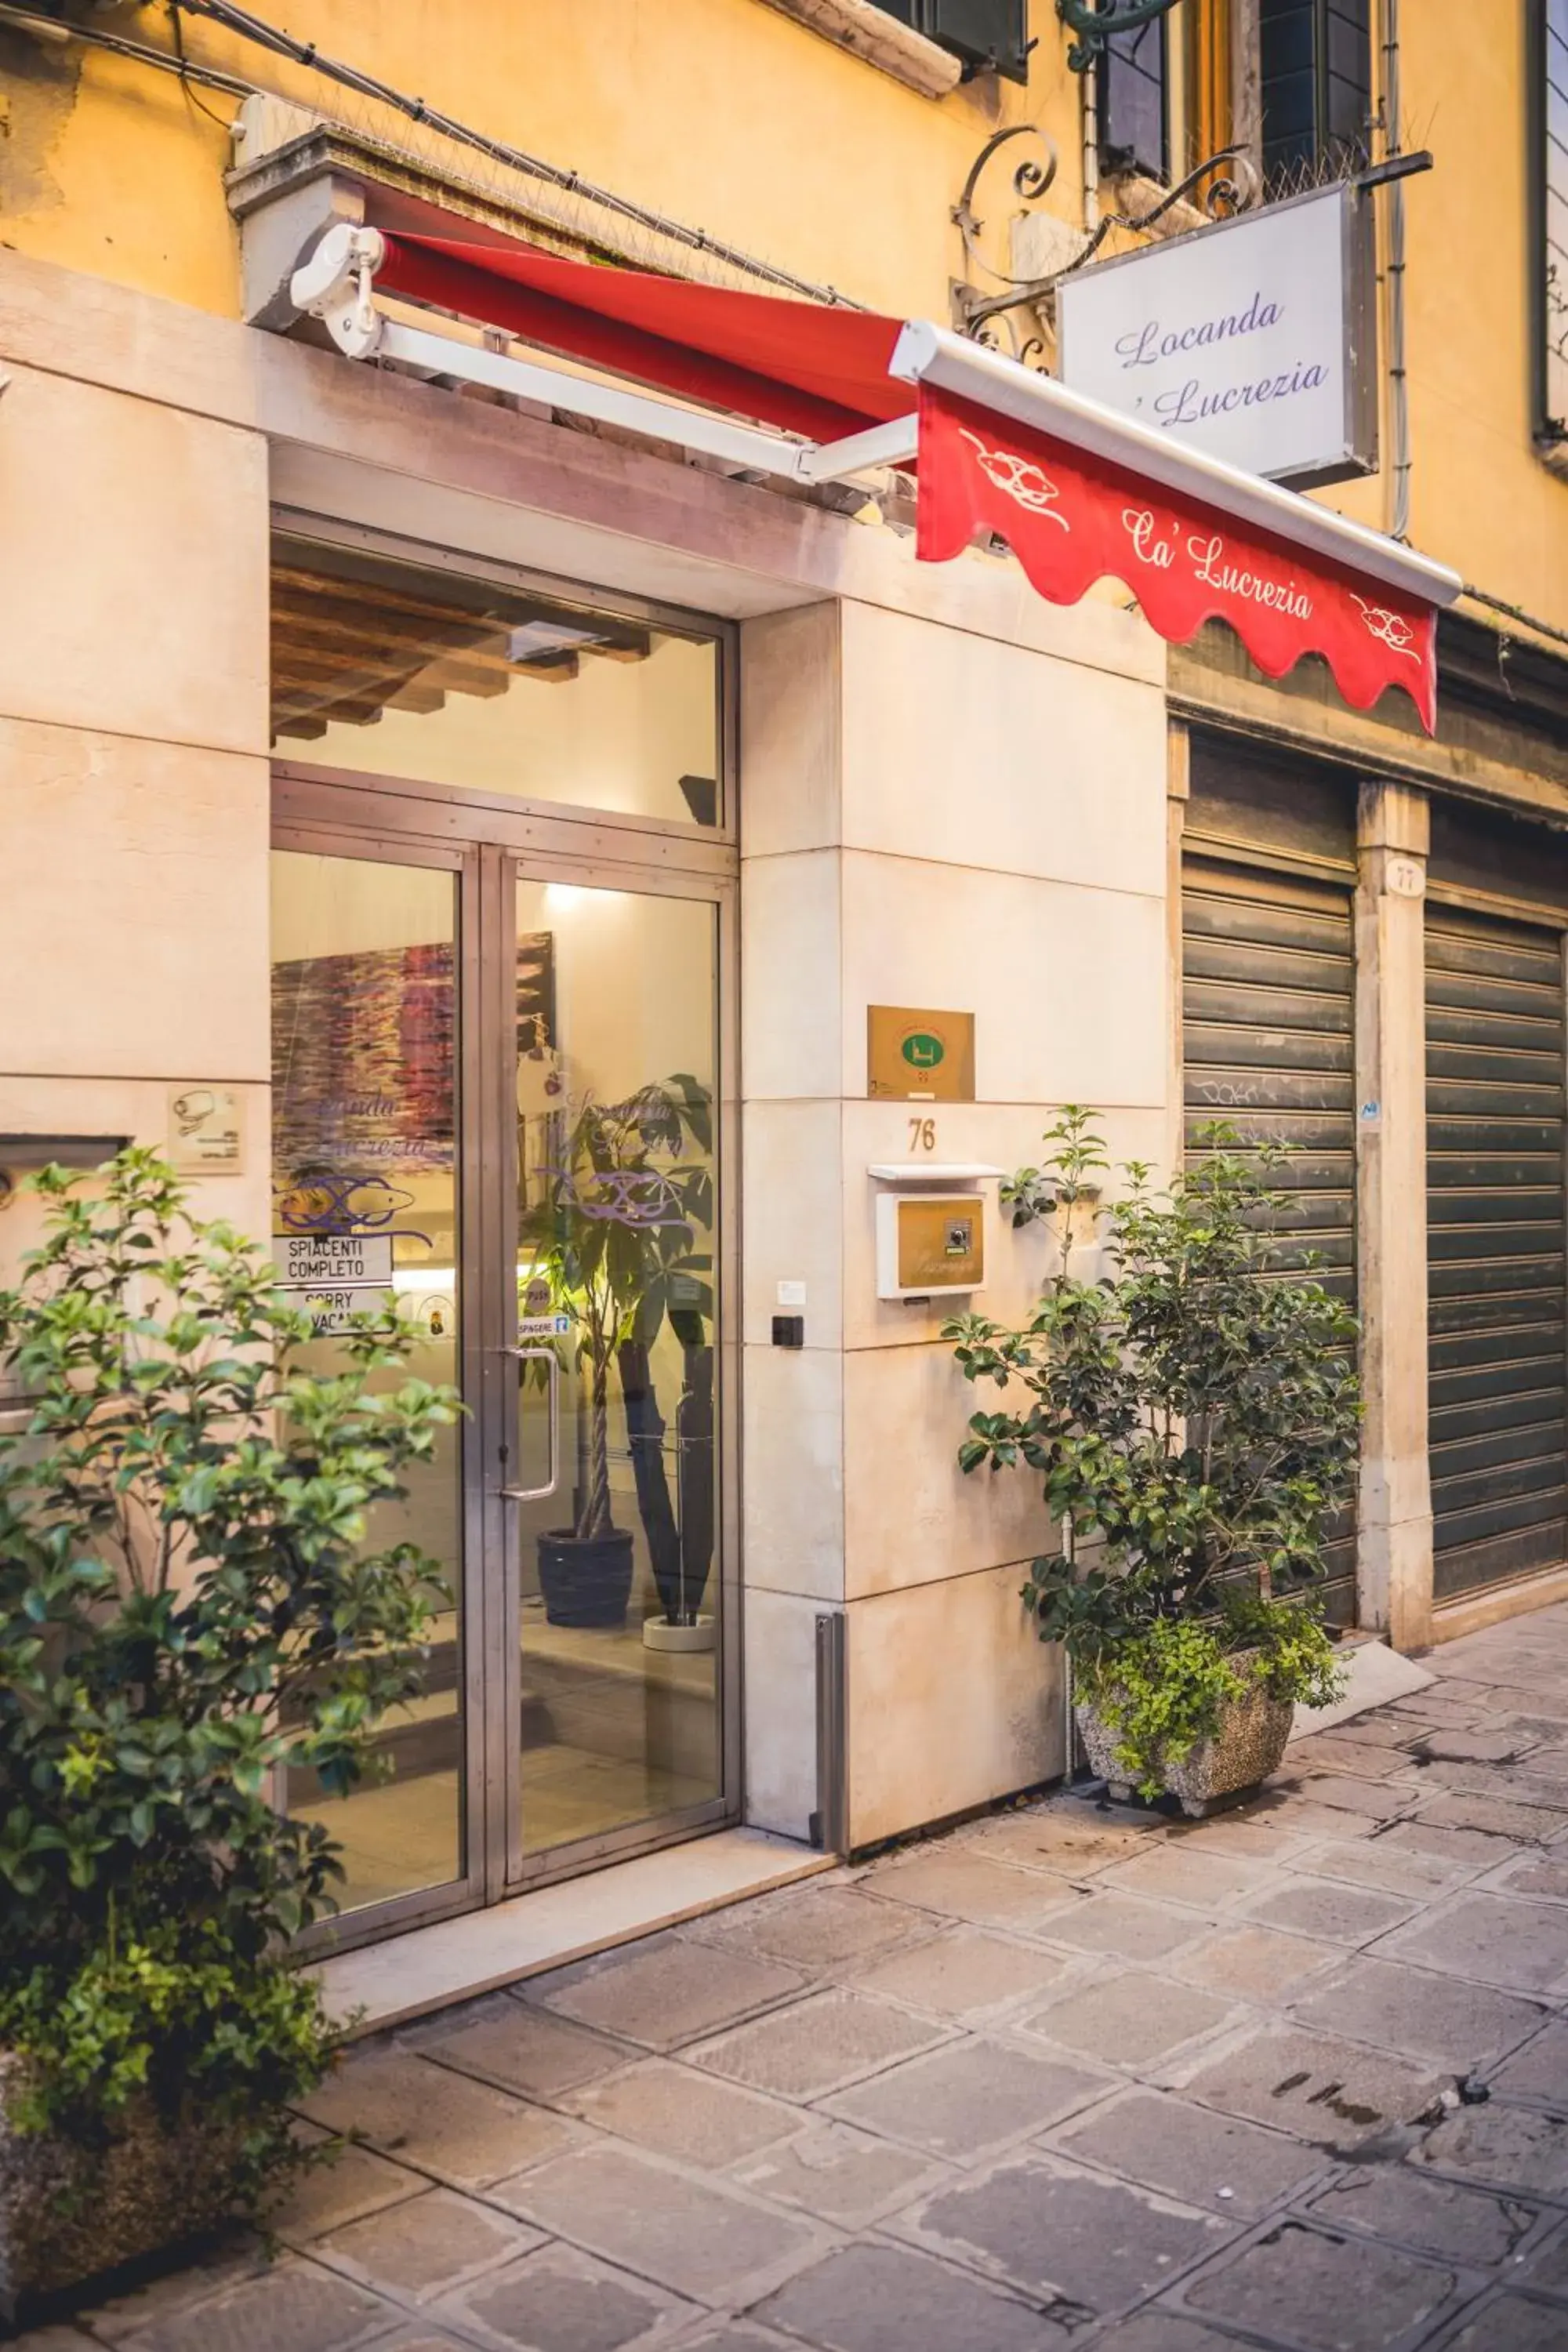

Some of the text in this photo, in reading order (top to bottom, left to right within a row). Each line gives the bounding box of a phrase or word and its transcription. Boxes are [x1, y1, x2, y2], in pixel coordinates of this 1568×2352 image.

[1115, 292, 1285, 368] Locanda
[1154, 358, 1330, 426] Lucrezia
[1122, 508, 1313, 619] Ca' Lucrezia
[909, 1118, 935, 1152] 76
[289, 1240, 363, 1257] SPIACENTI
[289, 1260, 364, 1277] COMPLETO
